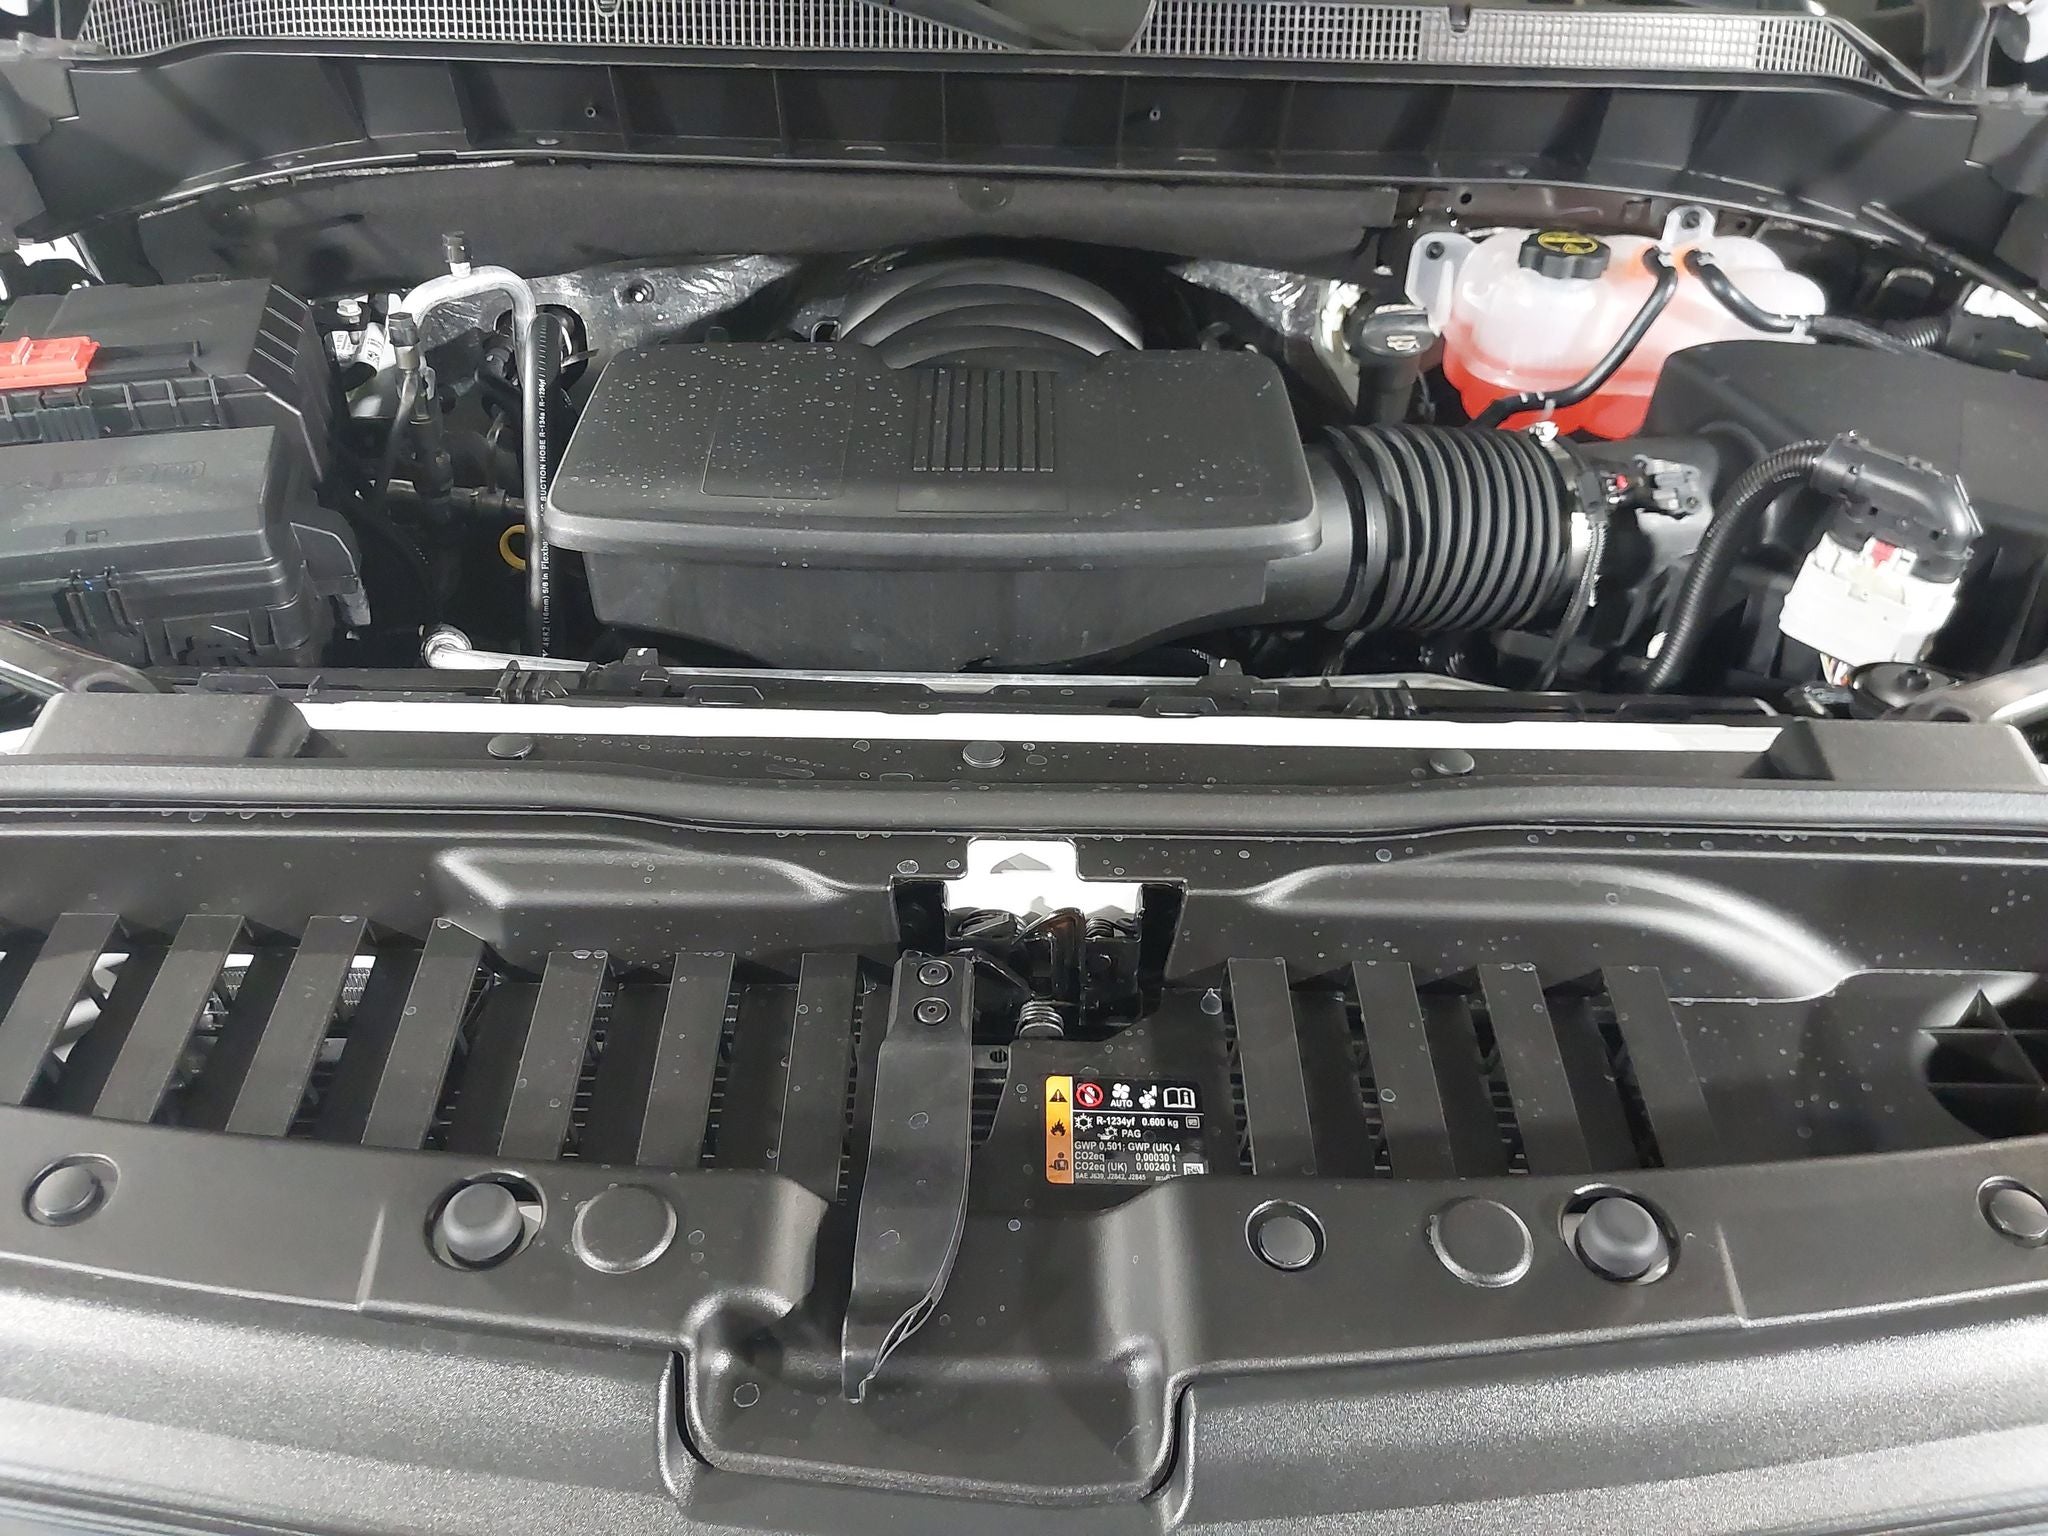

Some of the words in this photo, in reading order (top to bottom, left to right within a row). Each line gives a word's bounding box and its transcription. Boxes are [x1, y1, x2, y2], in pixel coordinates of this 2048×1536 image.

[541, 538, 549, 570] Flexba
[1096, 1116, 1135, 1127] R-1234yf
[1142, 1118, 1165, 1126] 0.600
[1168, 1118, 1178, 1128] kg
[1122, 1130, 1141, 1138] PAG
[1074, 1141, 1096, 1150] GWP
[1128, 1143, 1150, 1151] GWP
[1152, 1143, 1172, 1153] (UK)
[1174, 1144, 1180, 1152] 4
[1074, 1152, 1105, 1162] CO2eq
[1172, 1154, 1176, 1162] t
[1074, 1162, 1105, 1172] CO2eq
[1108, 1162, 1127, 1173] (UK)
[1172, 1164, 1176, 1172] t
